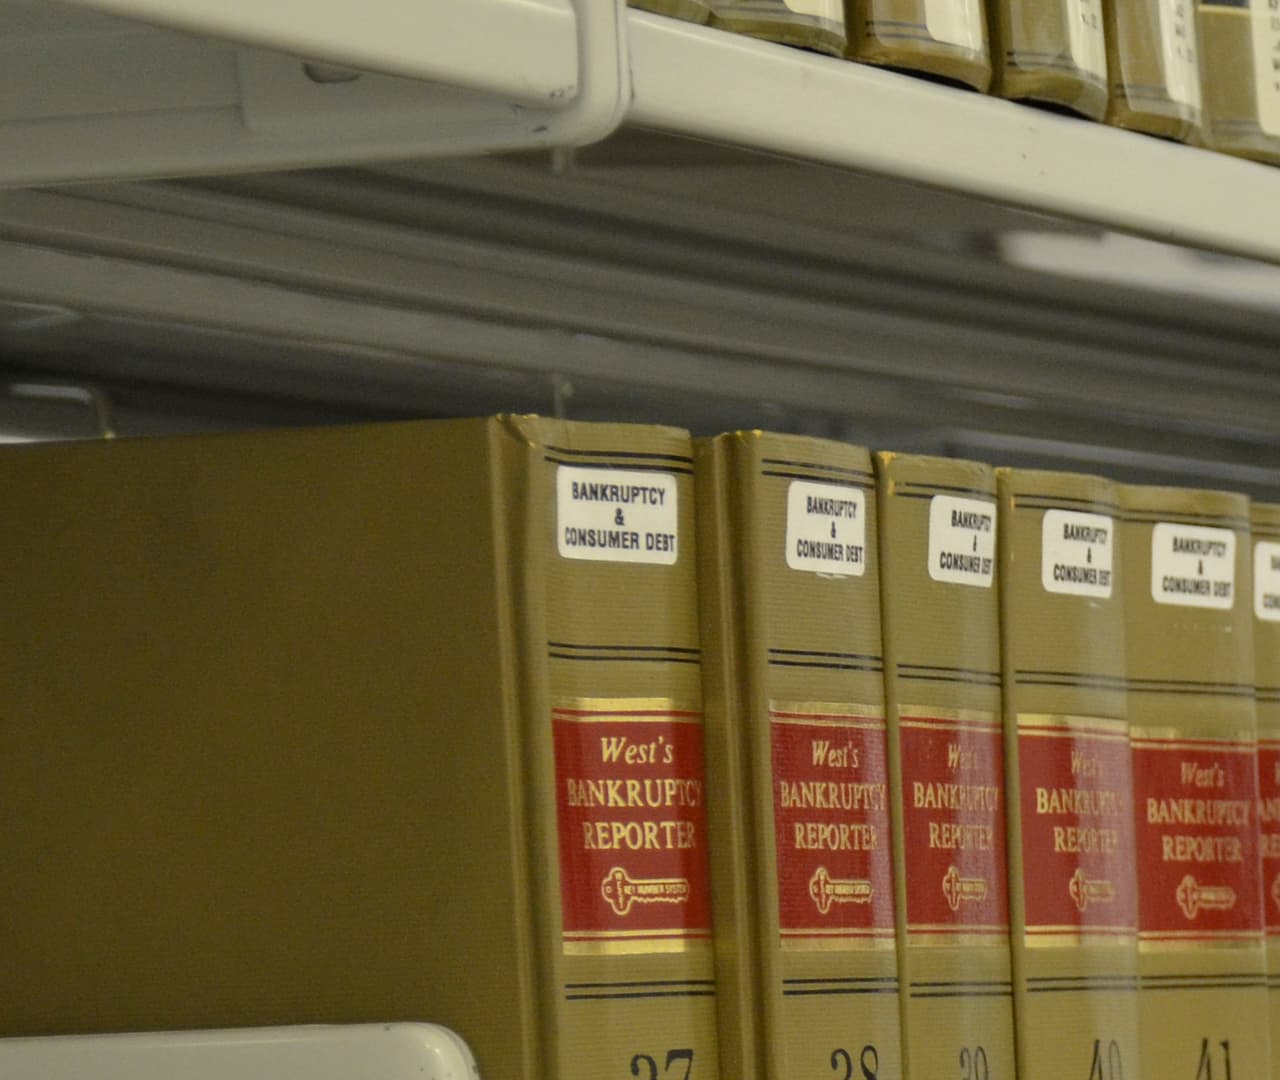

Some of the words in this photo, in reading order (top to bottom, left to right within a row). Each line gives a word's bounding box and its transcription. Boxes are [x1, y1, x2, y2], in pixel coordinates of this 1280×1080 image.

[572, 481, 665, 505] BANKRUPTCY
[614, 508, 624, 526] &
[806, 496, 857, 519] BANKRUPTCY
[565, 527, 640, 551] CONSUMER
[646, 533, 675, 553] DEBT
[830, 521, 836, 538] &
[797, 539, 844, 562] CONSUMER
[846, 545, 863, 564] DEBT
[939, 551, 981, 574] CONSUMER
[1053, 563, 1098, 586] CONSUMER
[601, 736, 674, 764] West's
[812, 740, 859, 768] West's
[568, 779, 702, 808] BANKRUPTCY
[780, 781, 887, 811] BANKRUPTCY
[584, 821, 696, 850] REPORTER
[795, 822, 877, 850] REPORTER
[1162, 835, 1243, 863] REPORTER
